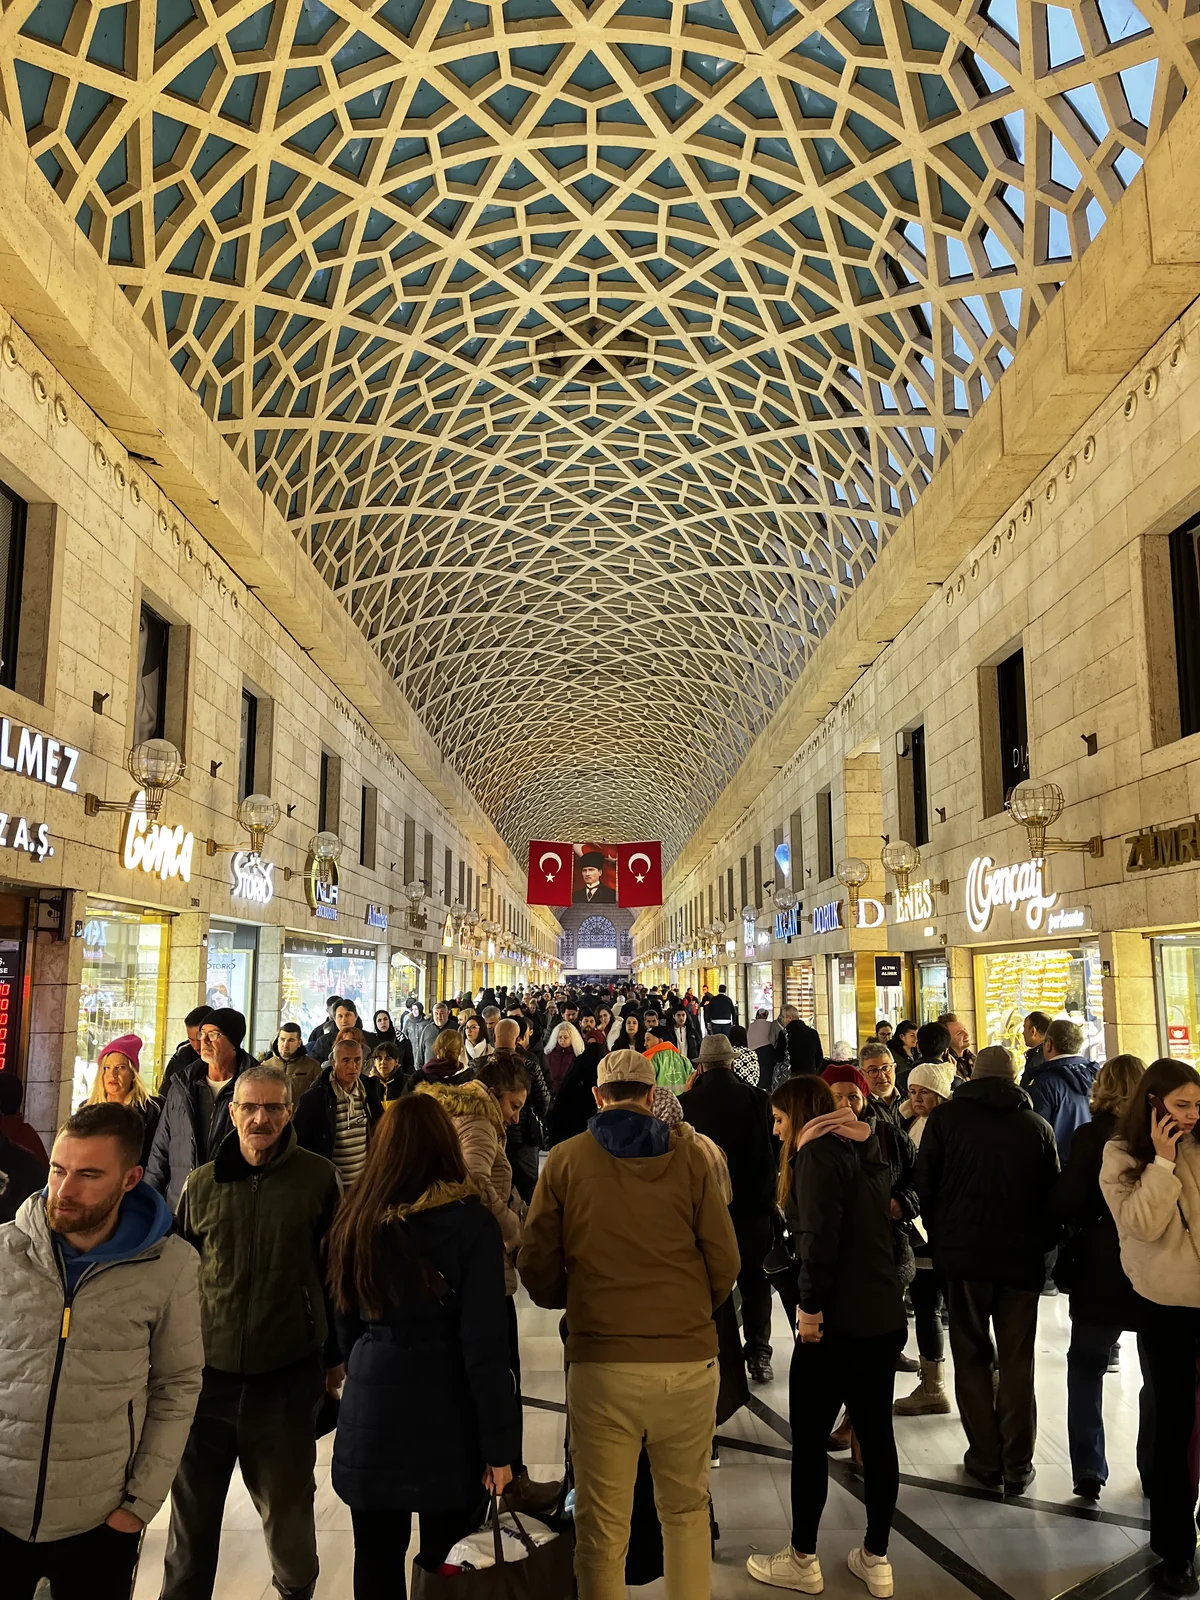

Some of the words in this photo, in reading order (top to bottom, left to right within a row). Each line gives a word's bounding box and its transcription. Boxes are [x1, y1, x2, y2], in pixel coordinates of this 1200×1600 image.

[856, 898, 885, 928] D
[894, 879, 932, 923] ENES
[966, 856, 1057, 933] Gençay
[813, 900, 841, 934] DORUK
